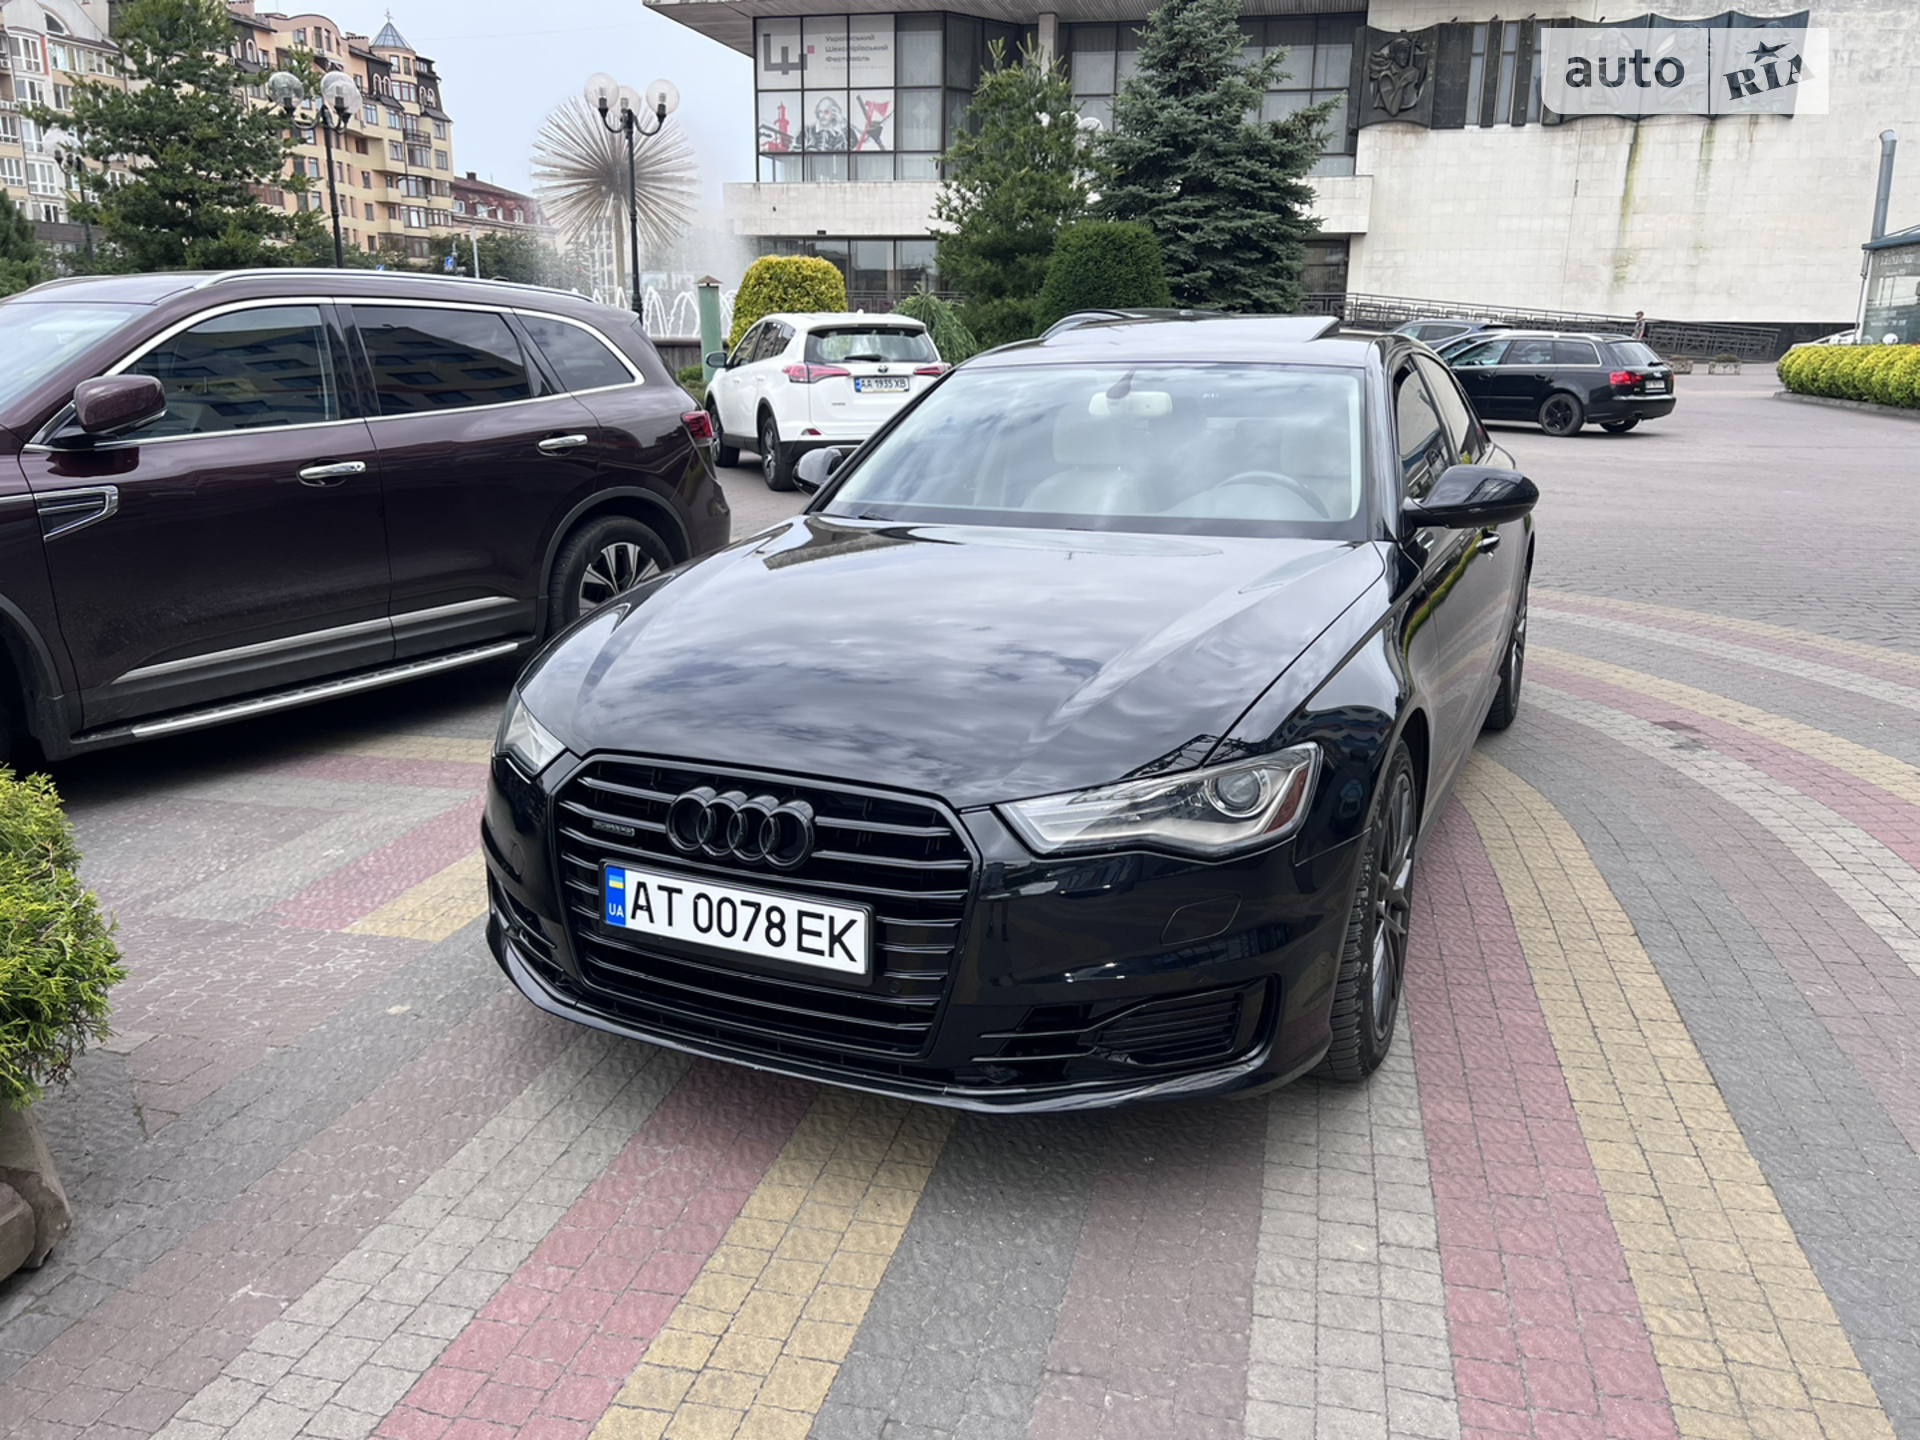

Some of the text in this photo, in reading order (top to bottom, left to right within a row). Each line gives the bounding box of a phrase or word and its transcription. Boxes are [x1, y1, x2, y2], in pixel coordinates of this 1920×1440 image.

[861, 379, 873, 389] AA
[874, 378, 893, 389] 1935
[608, 902, 625, 919] UA
[630, 880, 858, 963] AT 0078 EK
